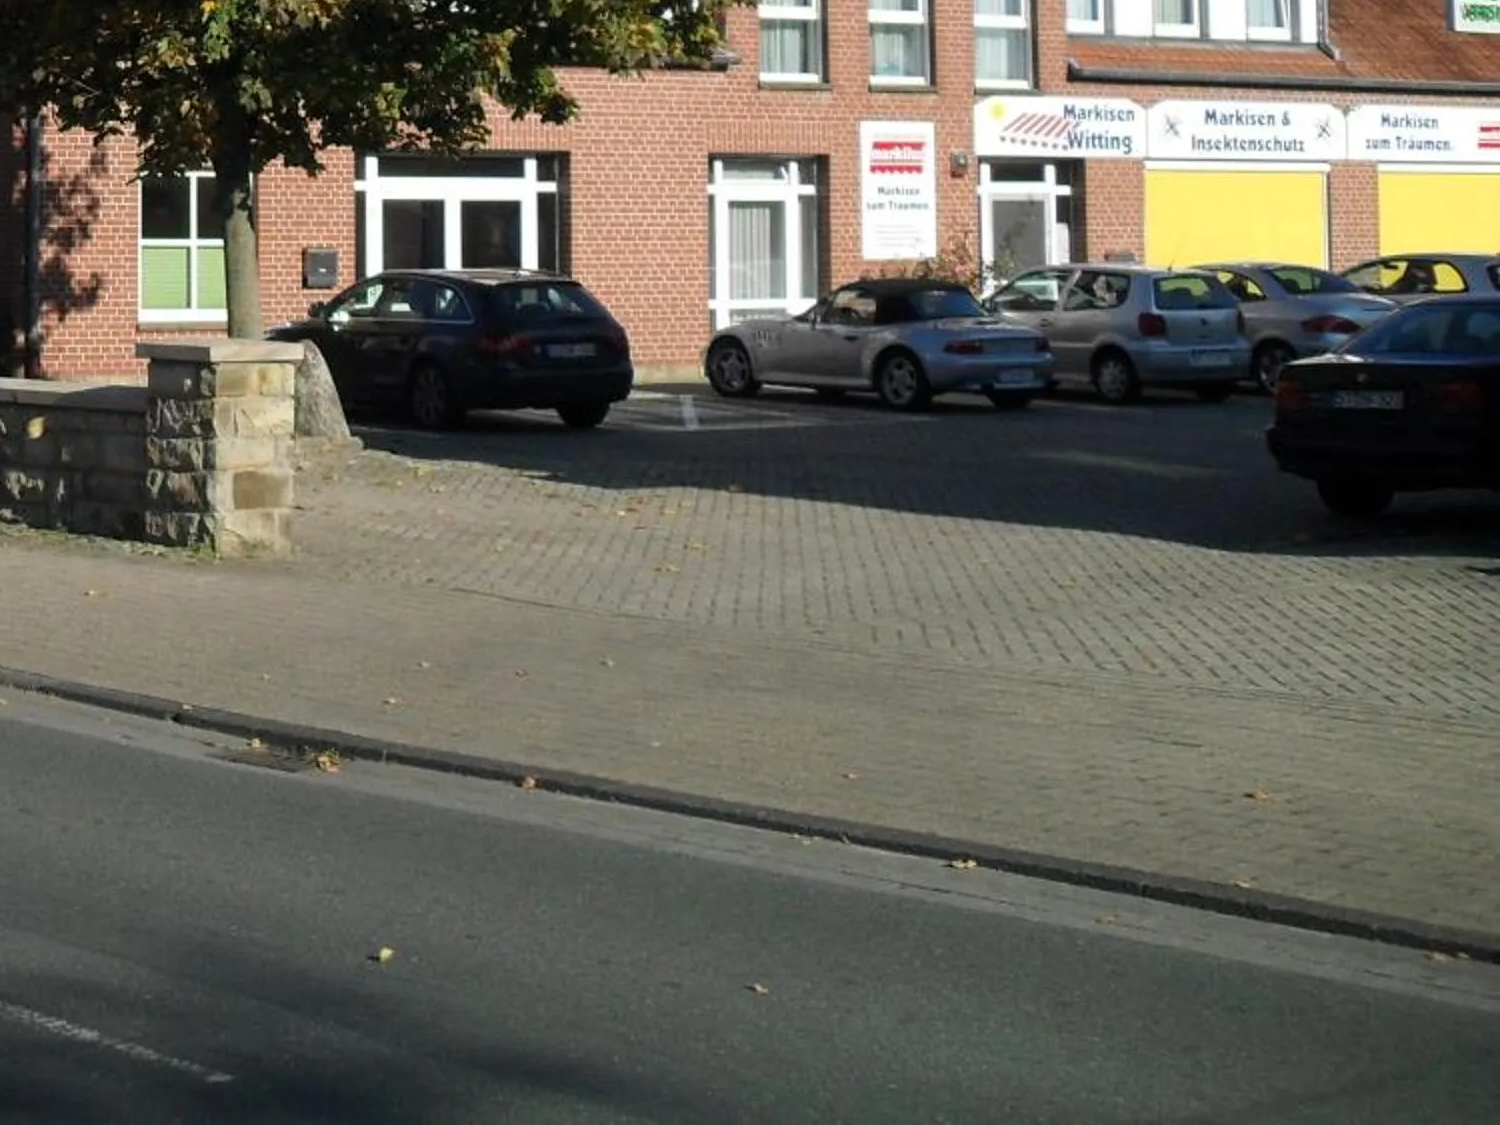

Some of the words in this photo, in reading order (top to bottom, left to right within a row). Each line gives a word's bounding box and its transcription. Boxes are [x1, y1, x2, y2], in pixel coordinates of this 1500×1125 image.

[1063, 104, 1135, 121] Markisen
[1204, 108, 1276, 126] Markisen
[1281, 109, 1291, 126] &
[1380, 113, 1439, 129] Markisen
[1066, 128, 1133, 154] Witting
[1191, 134, 1305, 152] Insektenschutz
